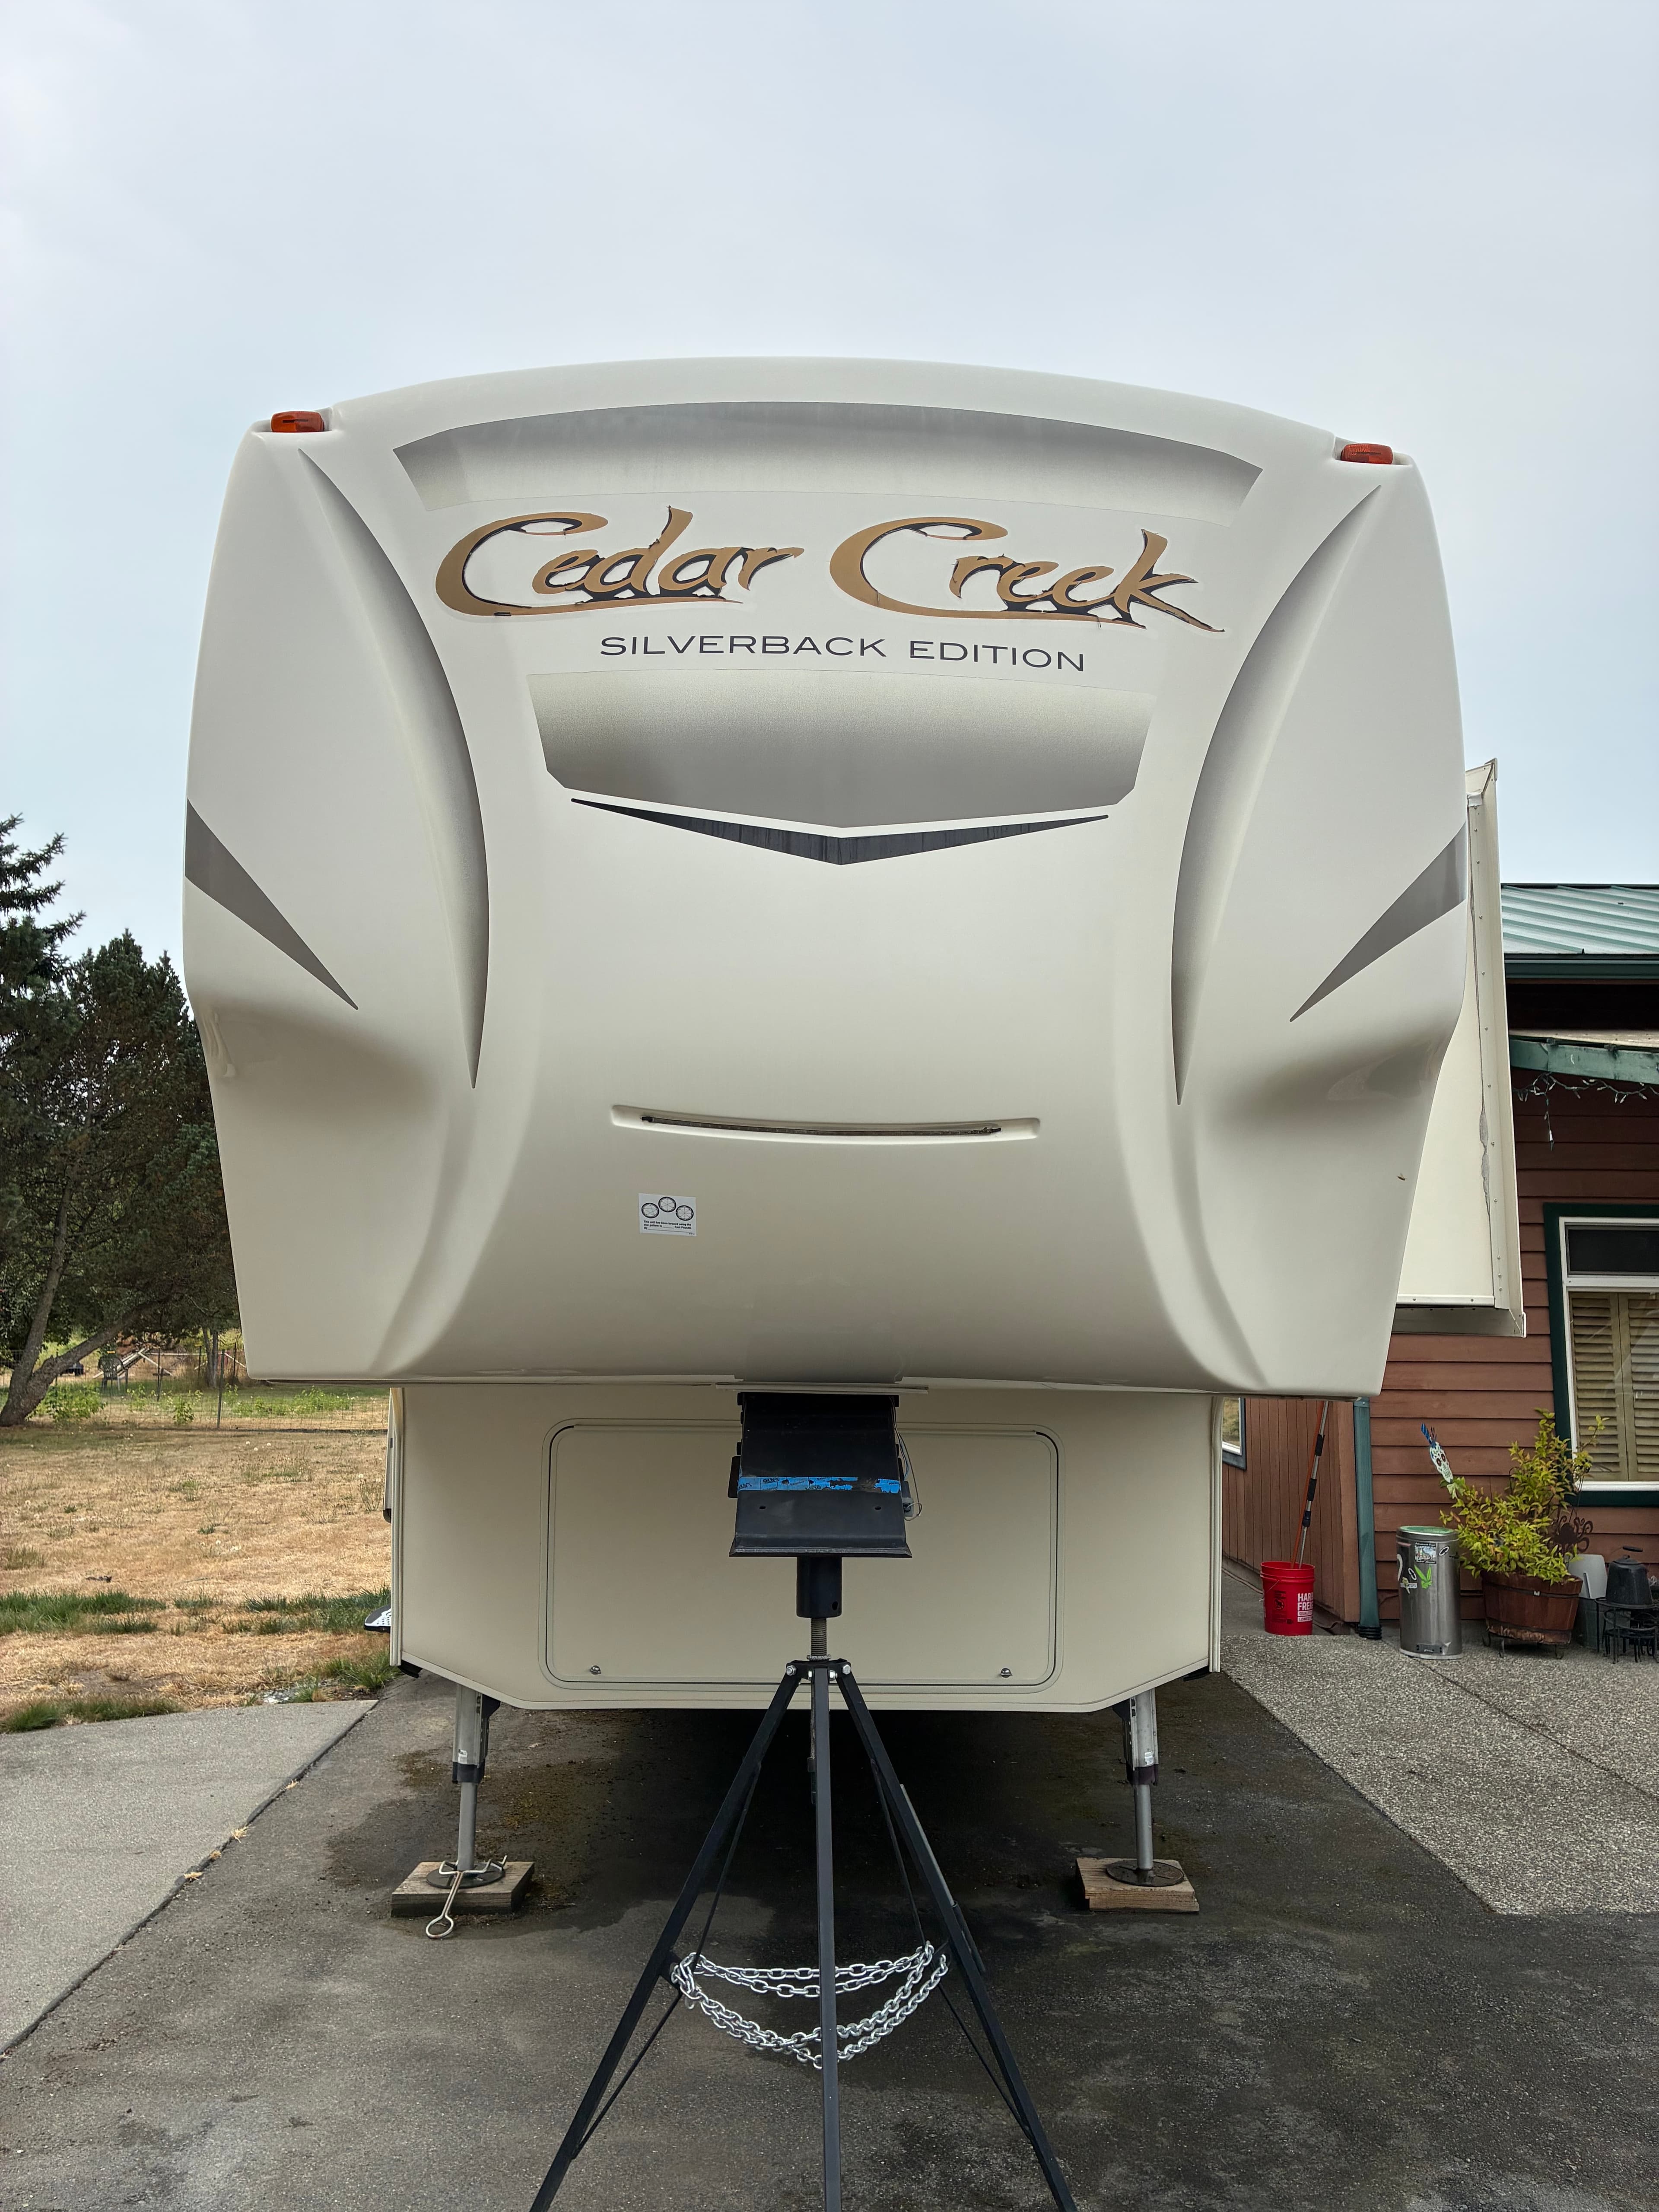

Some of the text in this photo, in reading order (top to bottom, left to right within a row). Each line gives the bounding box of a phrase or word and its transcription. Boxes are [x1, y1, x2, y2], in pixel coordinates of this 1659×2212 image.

[435, 505, 1225, 632] Cedar Creek
[600, 635, 1084, 671] SILVERBACK EDITION
